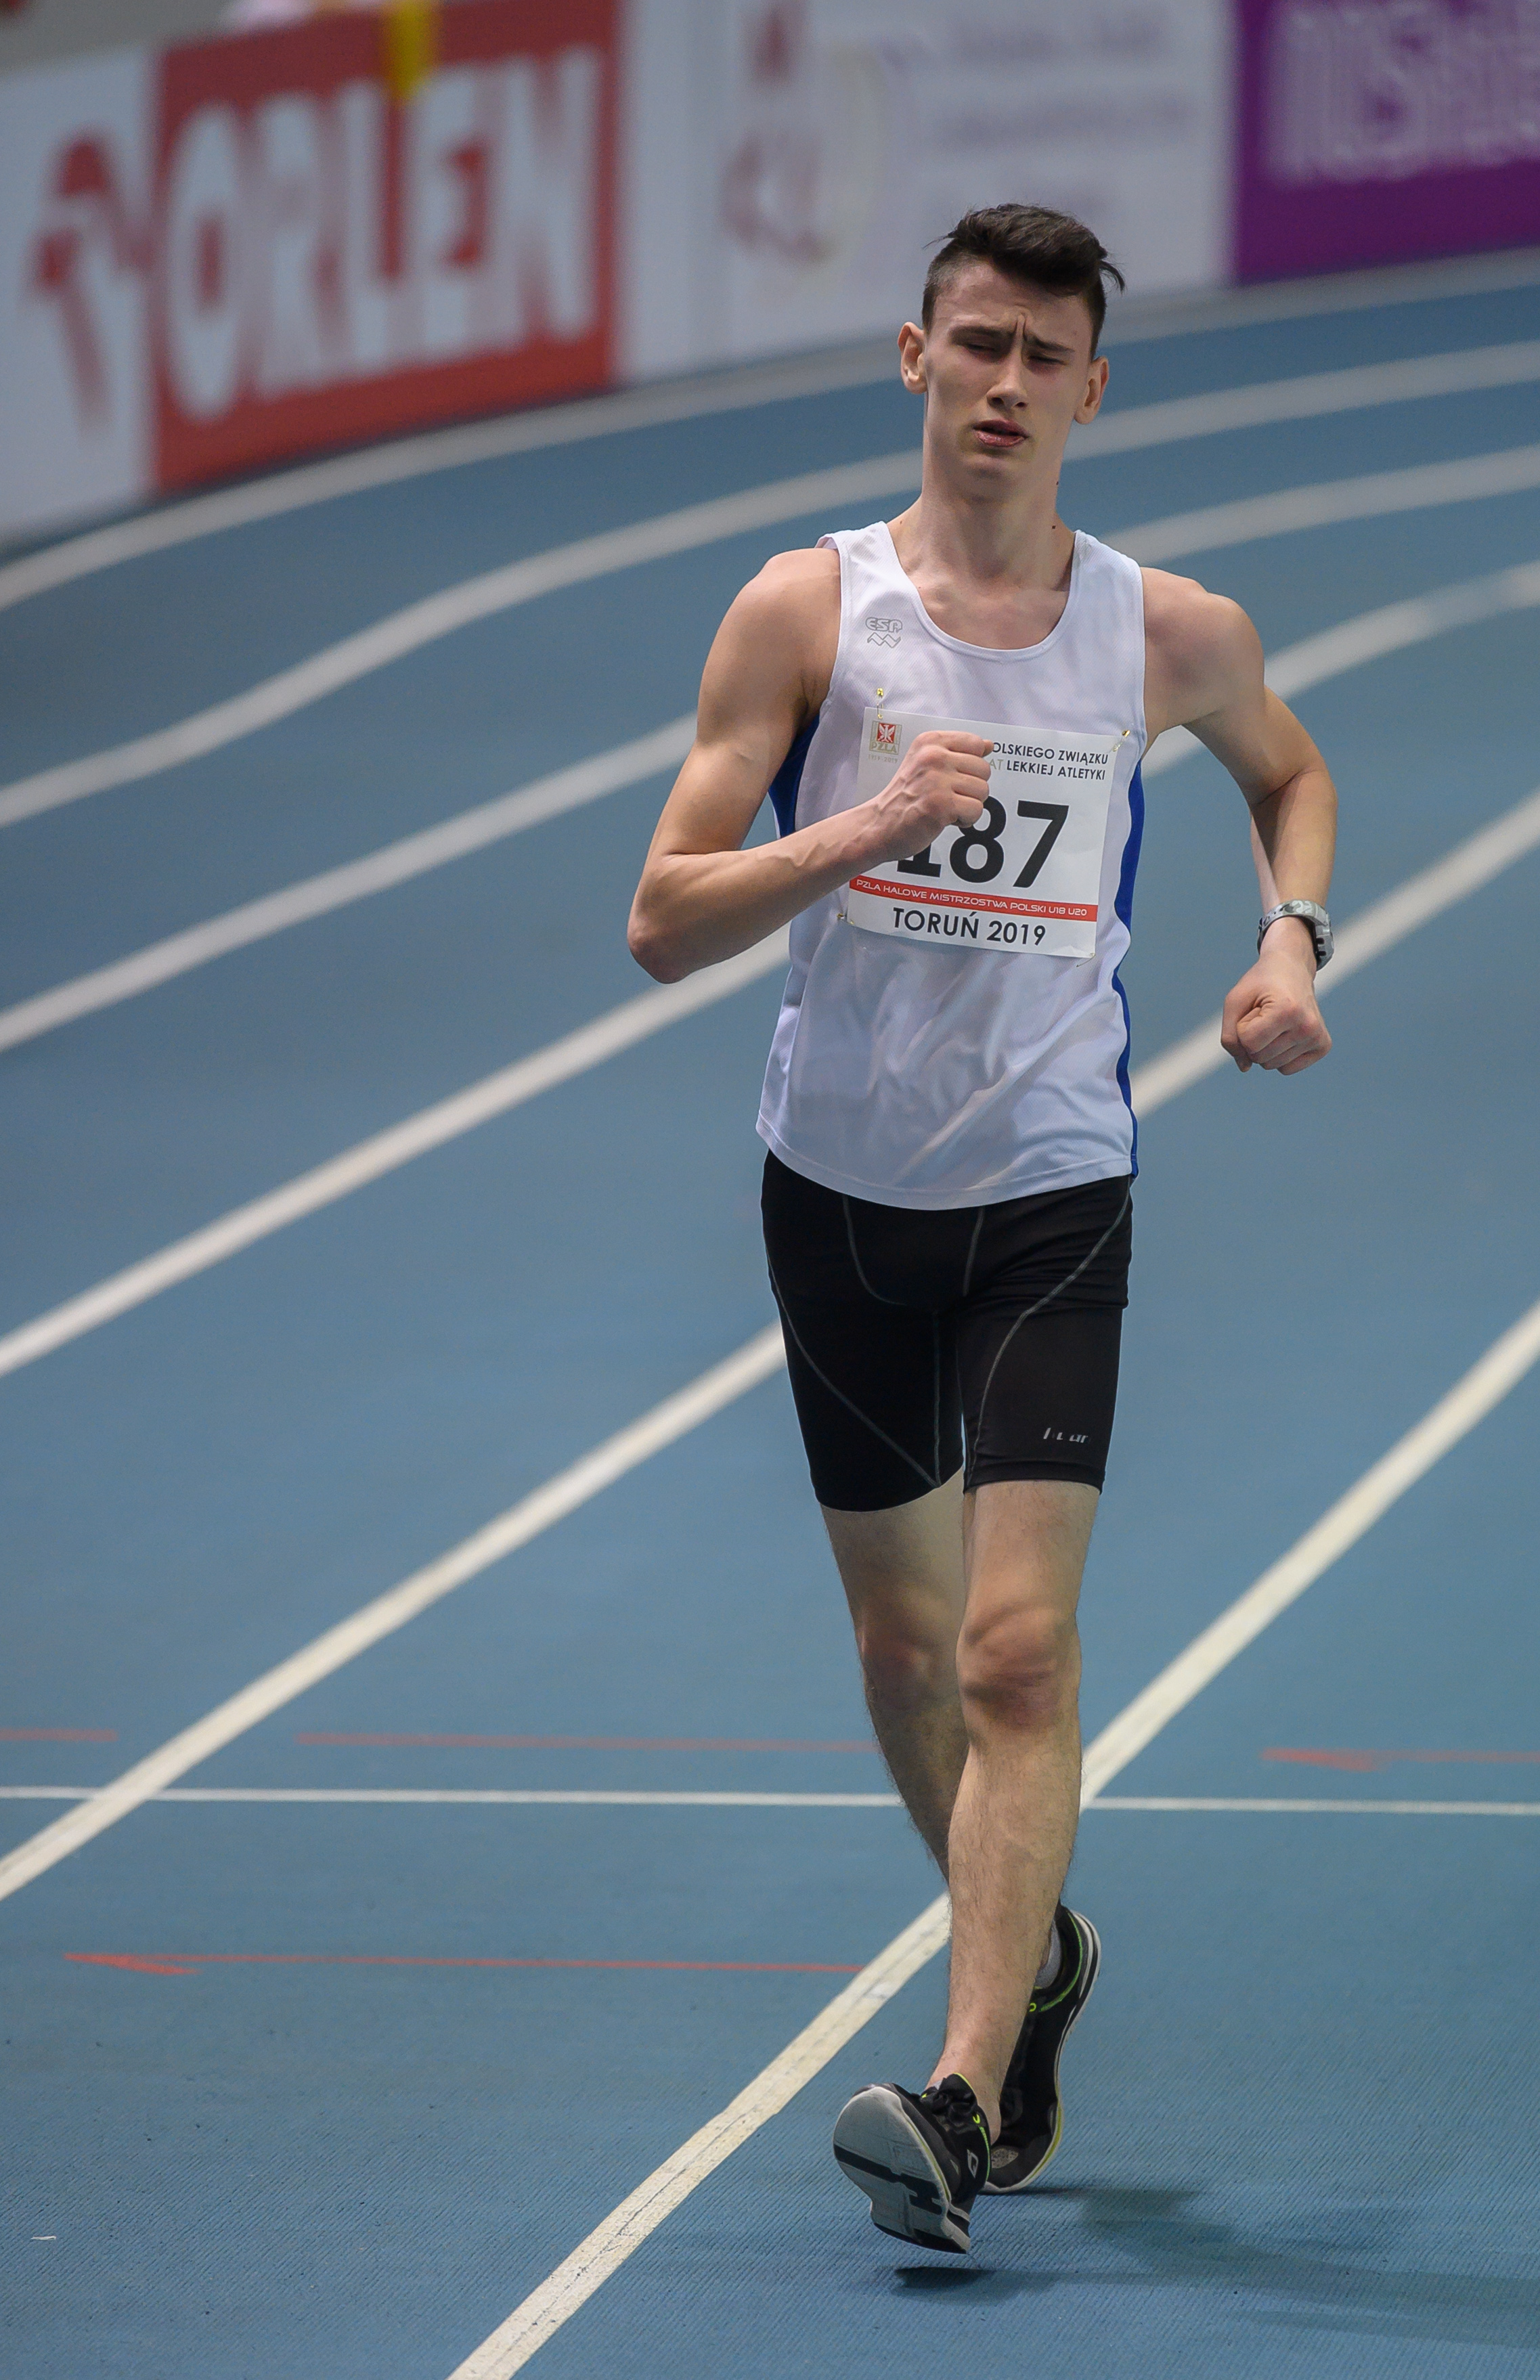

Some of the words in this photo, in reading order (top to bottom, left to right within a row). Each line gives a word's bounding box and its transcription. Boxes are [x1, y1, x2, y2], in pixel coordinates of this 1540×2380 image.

[992, 742, 1055, 759] OLSKIEGO
[1058, 750, 1108, 766] ZWIĄZKU
[989, 759, 1003, 770] AT
[1007, 760, 1053, 776] LEKKIEJ
[1057, 766, 1105, 780] ATLETYKI
[856, 879, 881, 891] PZLA
[883, 885, 927, 899] HALOWE
[929, 893, 1008, 909] MISTRZOSTWA
[1010, 902, 1047, 912] POLSKI
[893, 907, 979, 939] TORUŃ
[986, 921, 1046, 946] 2019
